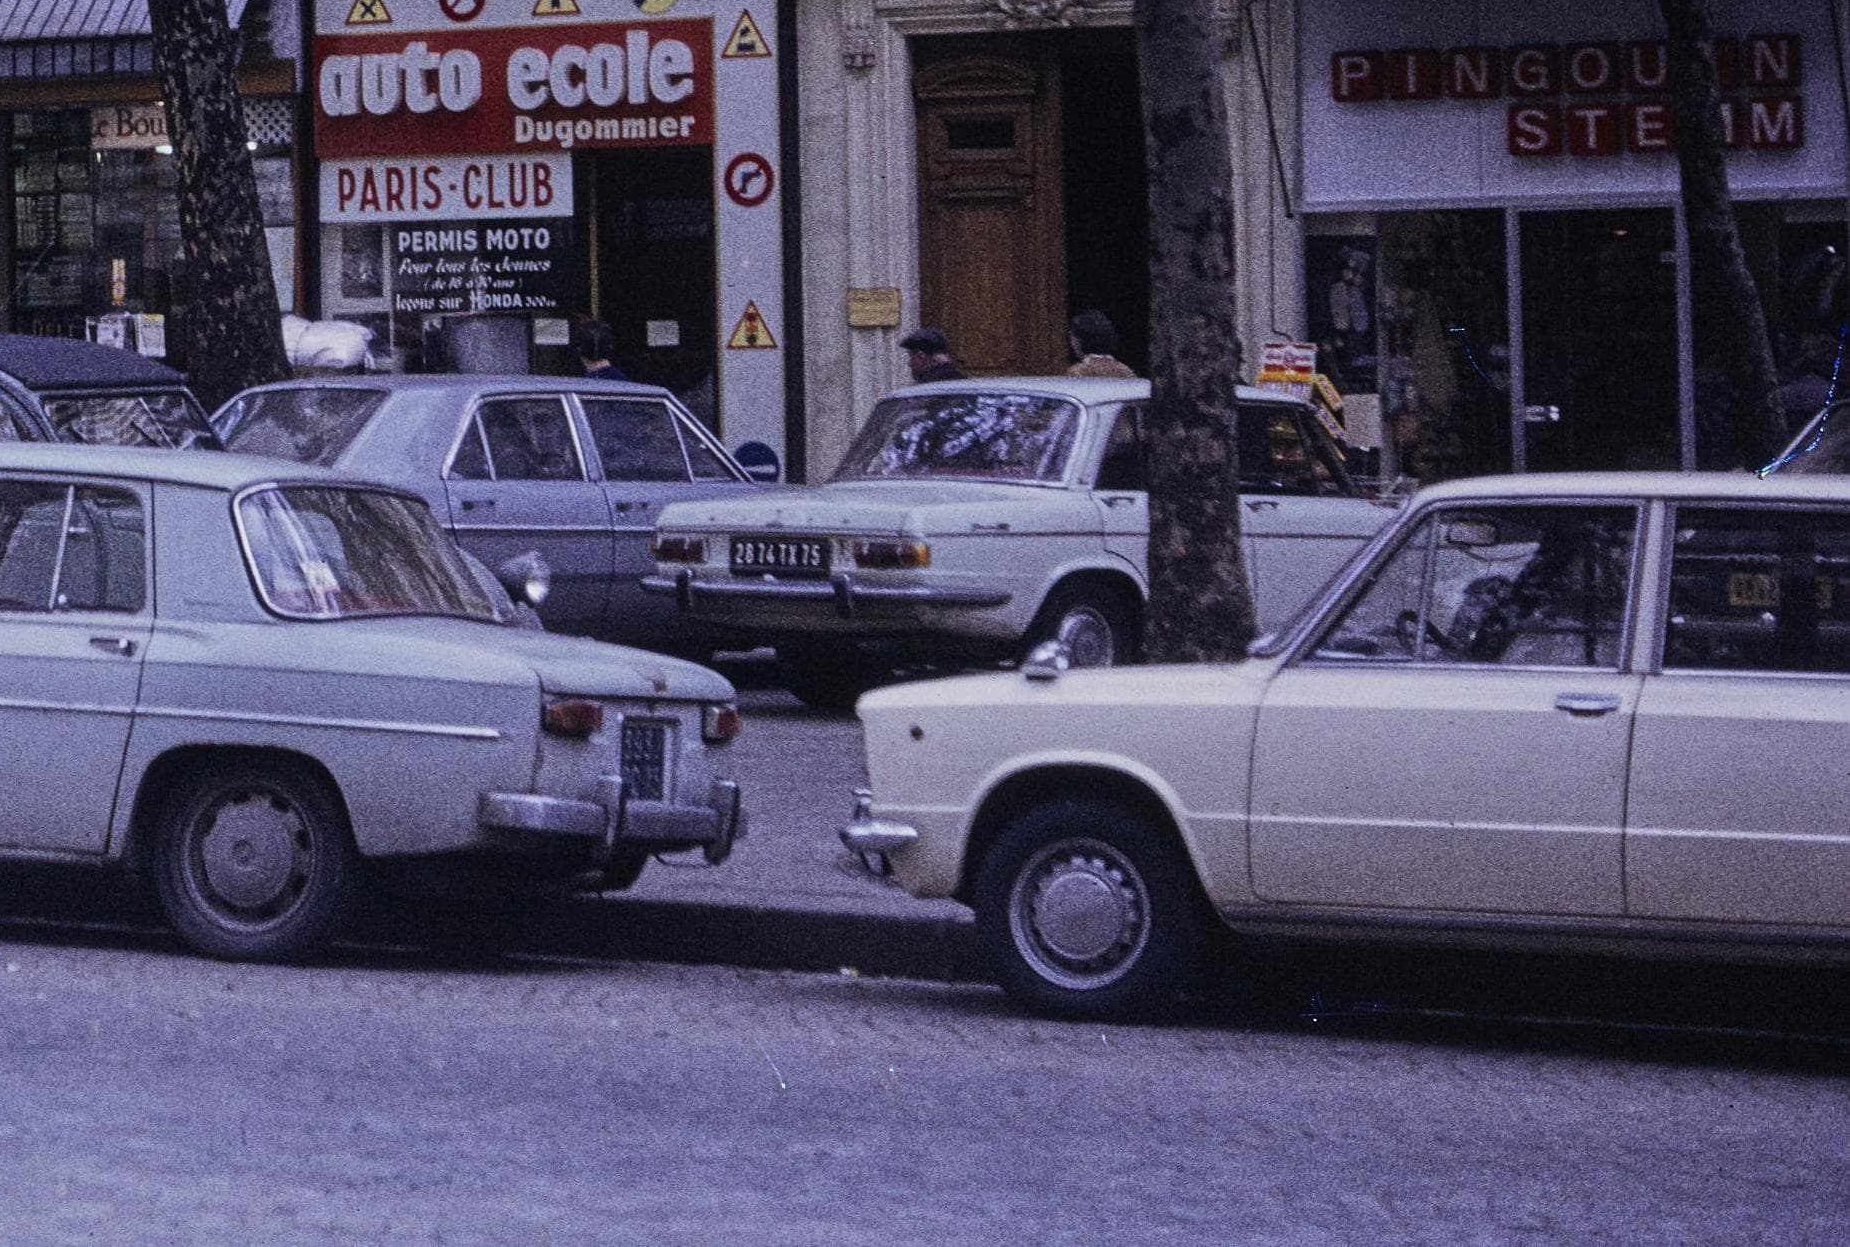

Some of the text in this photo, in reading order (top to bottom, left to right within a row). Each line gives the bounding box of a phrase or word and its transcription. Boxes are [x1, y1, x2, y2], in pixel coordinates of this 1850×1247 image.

[319, 30, 694, 117] auto ecole
[1339, 40, 1789, 96] PINGOUN
[515, 116, 694, 149] Dugommier
[398, 227, 550, 252] PERMIS MOTO
[439, 297, 463, 309] sur
[470, 292, 523, 312] HONDA
